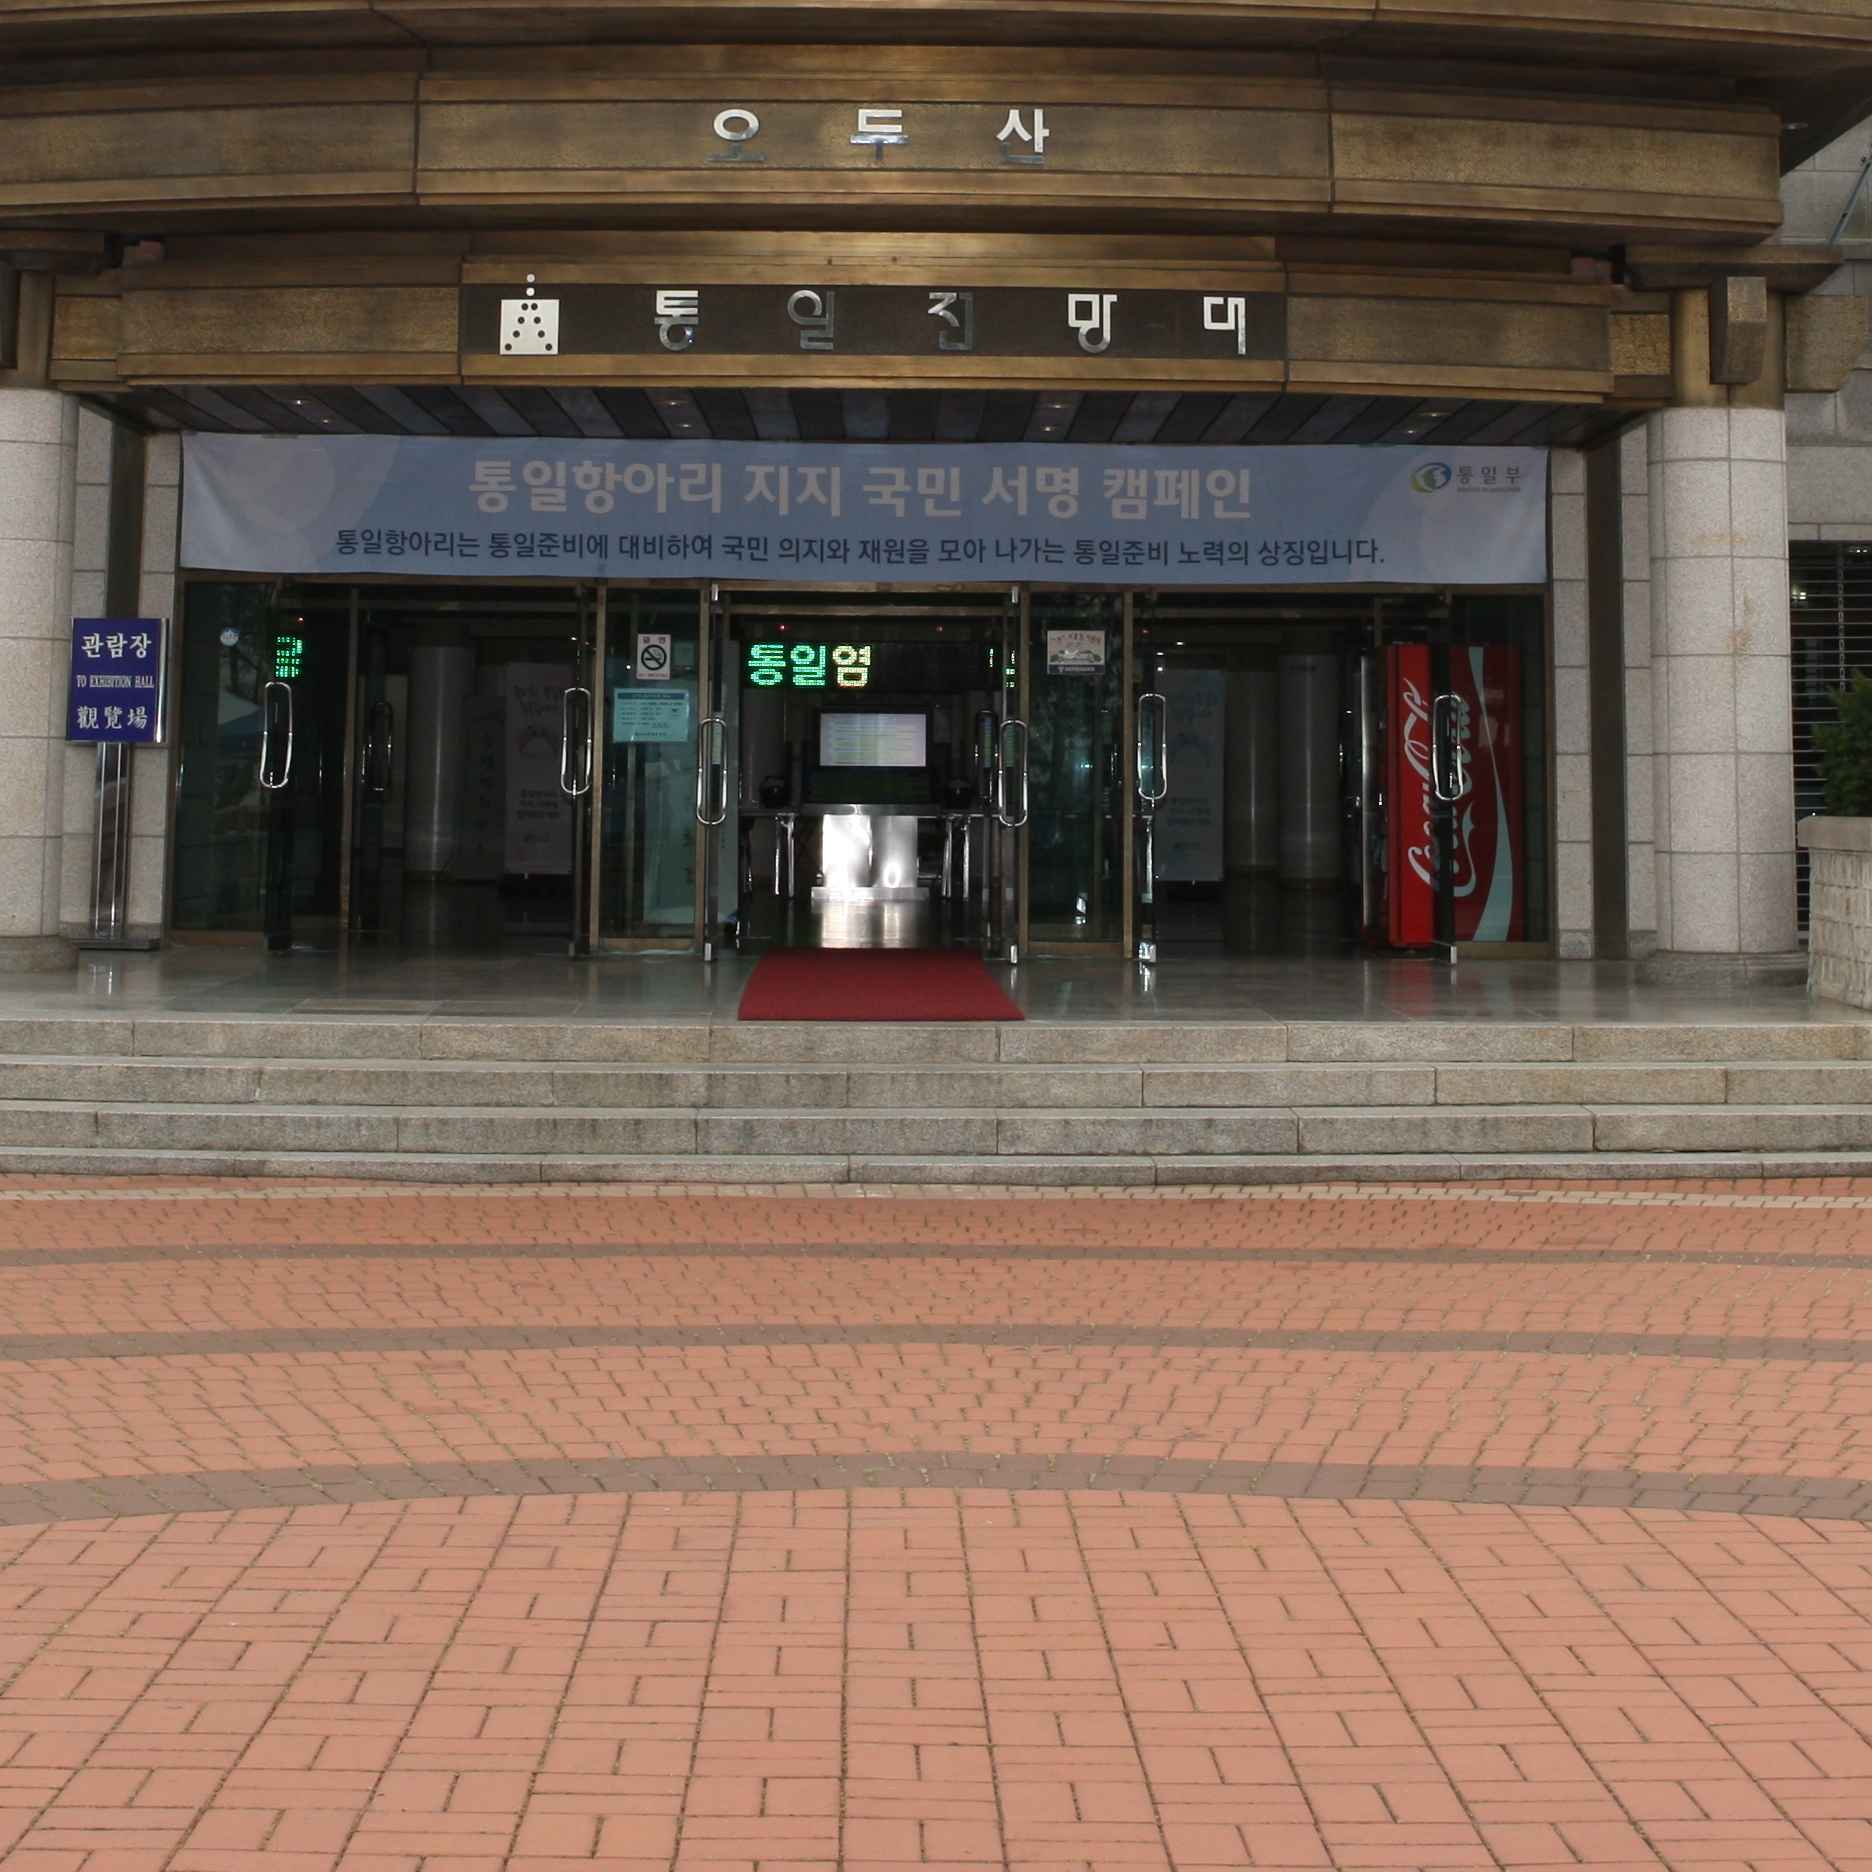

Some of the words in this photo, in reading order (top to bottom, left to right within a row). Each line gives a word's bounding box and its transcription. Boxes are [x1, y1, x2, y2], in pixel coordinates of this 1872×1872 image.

[705, 108, 1050, 165] 오두산
[654, 290, 1247, 356] 통일전망대
[468, 461, 720, 514] 통일항아리
[743, 463, 841, 517] 지지
[862, 466, 962, 516] 국민
[981, 466, 1079, 520] 서명
[1103, 468, 1252, 520] 캠페인
[1456, 465, 1521, 485] 통일부
[336, 529, 480, 558] 통일항아리는
[488, 532, 608, 560] 통일준비에
[619, 534, 713, 560] 대비하여
[722, 536, 769, 562] 국민
[778, 538, 850, 564] 의지와
[858, 539, 929, 565] 재원을
[938, 538, 986, 563] 모아
[995, 538, 1065, 564] 나가는
[1072, 540, 1168, 566] 통일준비
[1178, 540, 1249, 566] 노력의
[1258, 538, 1385, 566] 상징입니다.
[82, 633, 151, 658] 관람장
[76, 674, 88, 688] TO
[135, 675, 154, 688] HALL
[748, 644, 871, 688] 통일염
